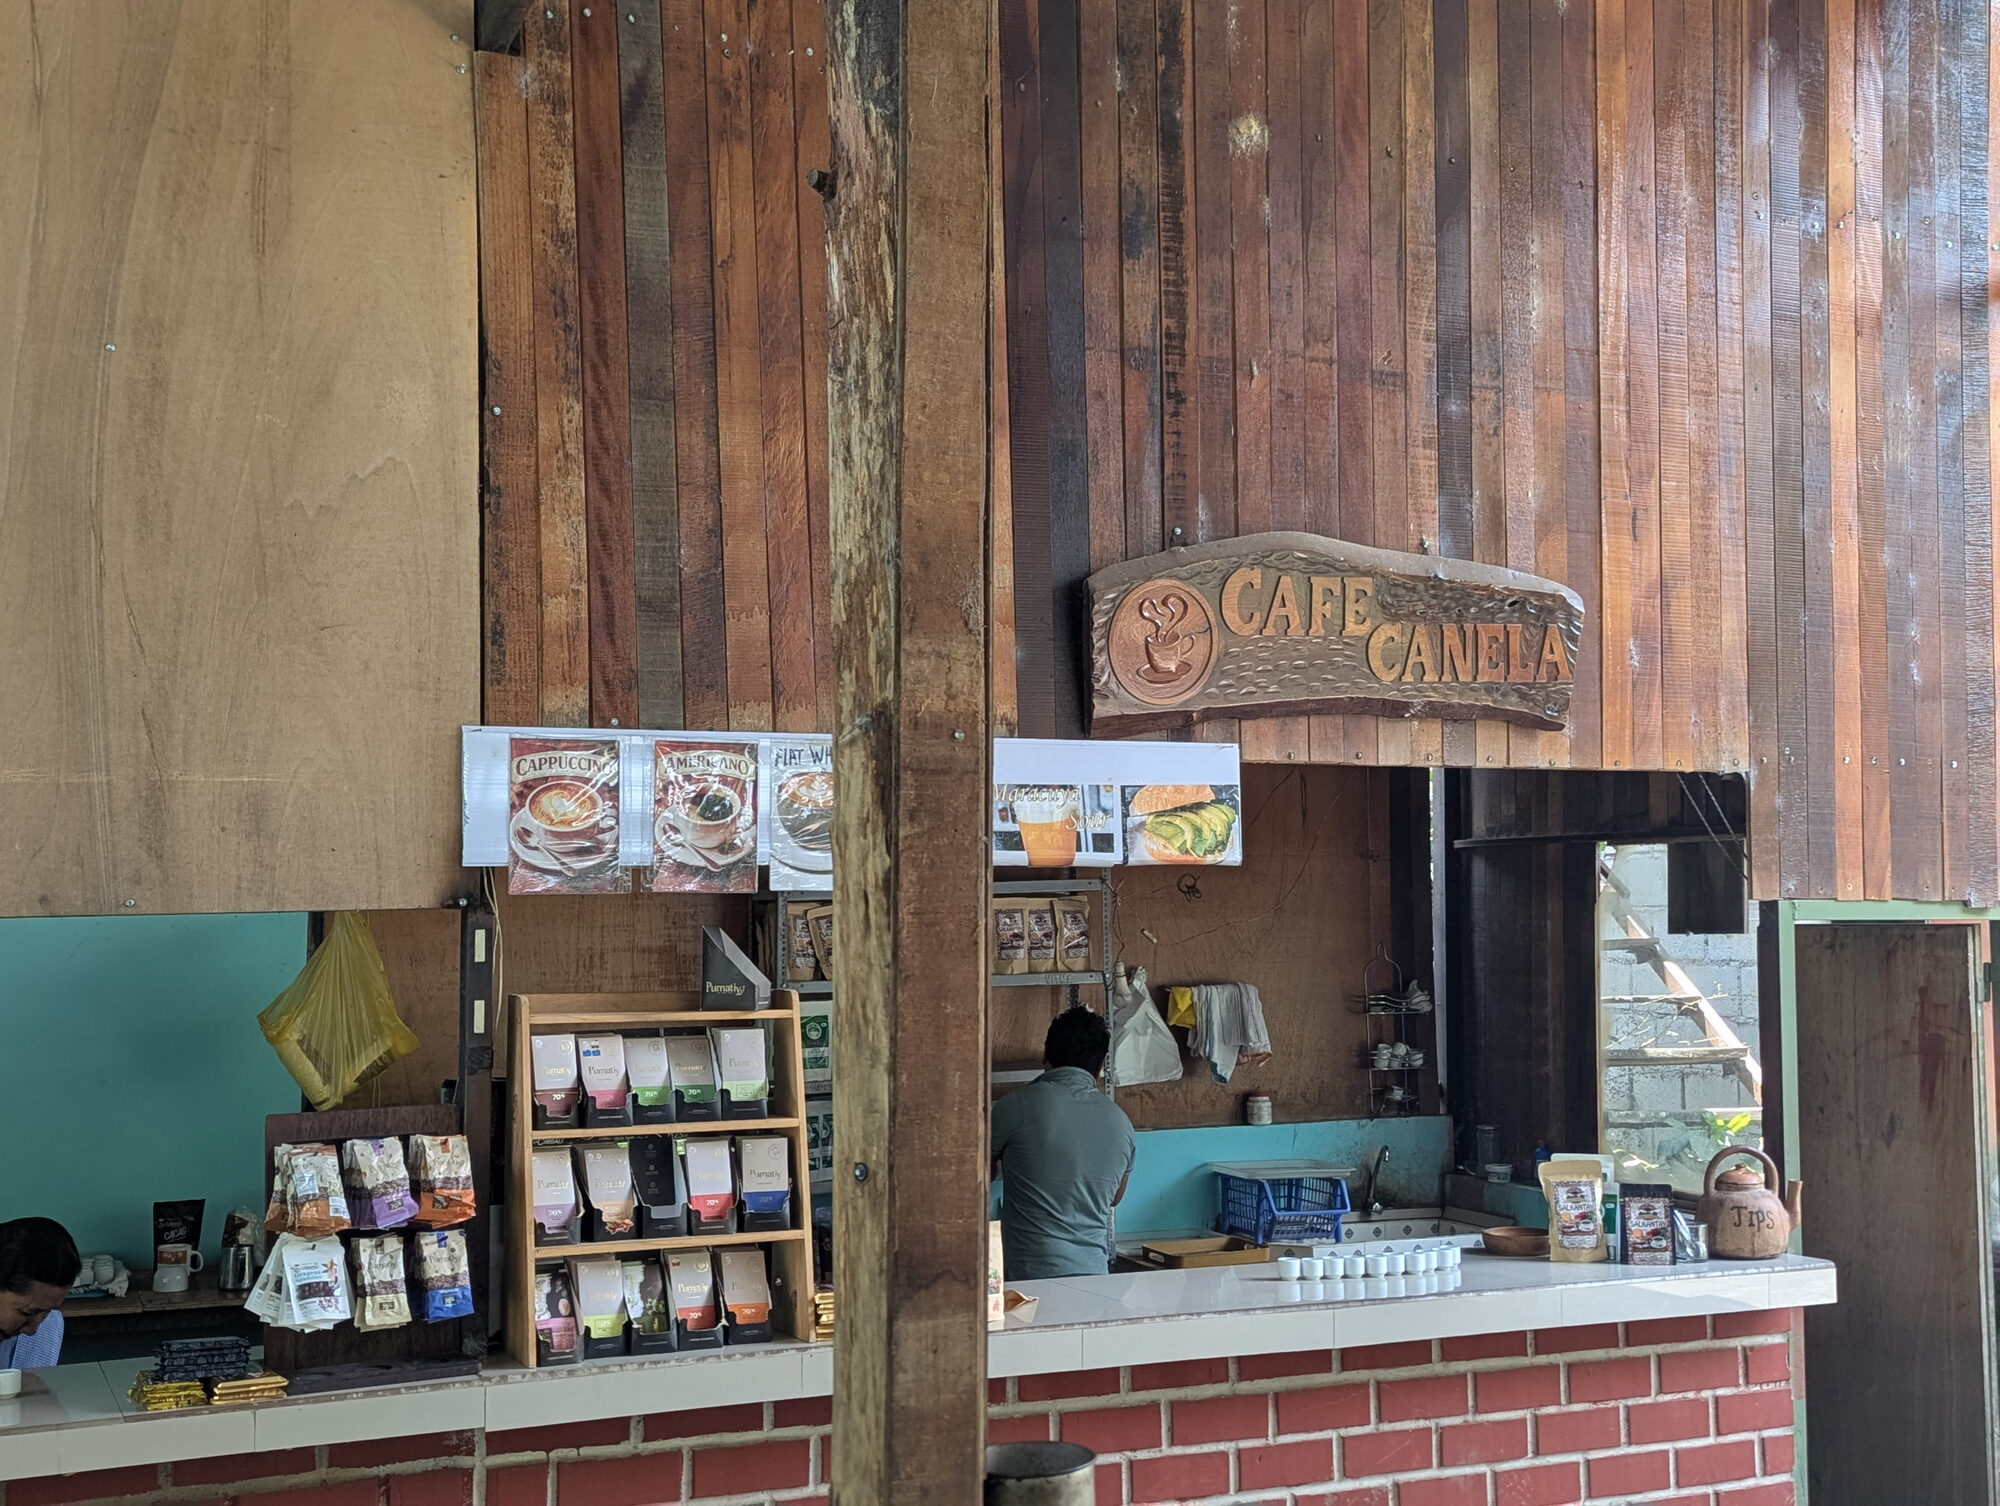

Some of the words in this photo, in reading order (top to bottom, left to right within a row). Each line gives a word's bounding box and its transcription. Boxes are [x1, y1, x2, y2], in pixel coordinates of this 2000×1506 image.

[1220, 568, 1374, 638] CAFE
[1367, 622, 1573, 683] CANELA
[775, 747, 804, 767] FLAT
[1065, 811, 1112, 831] Sour
